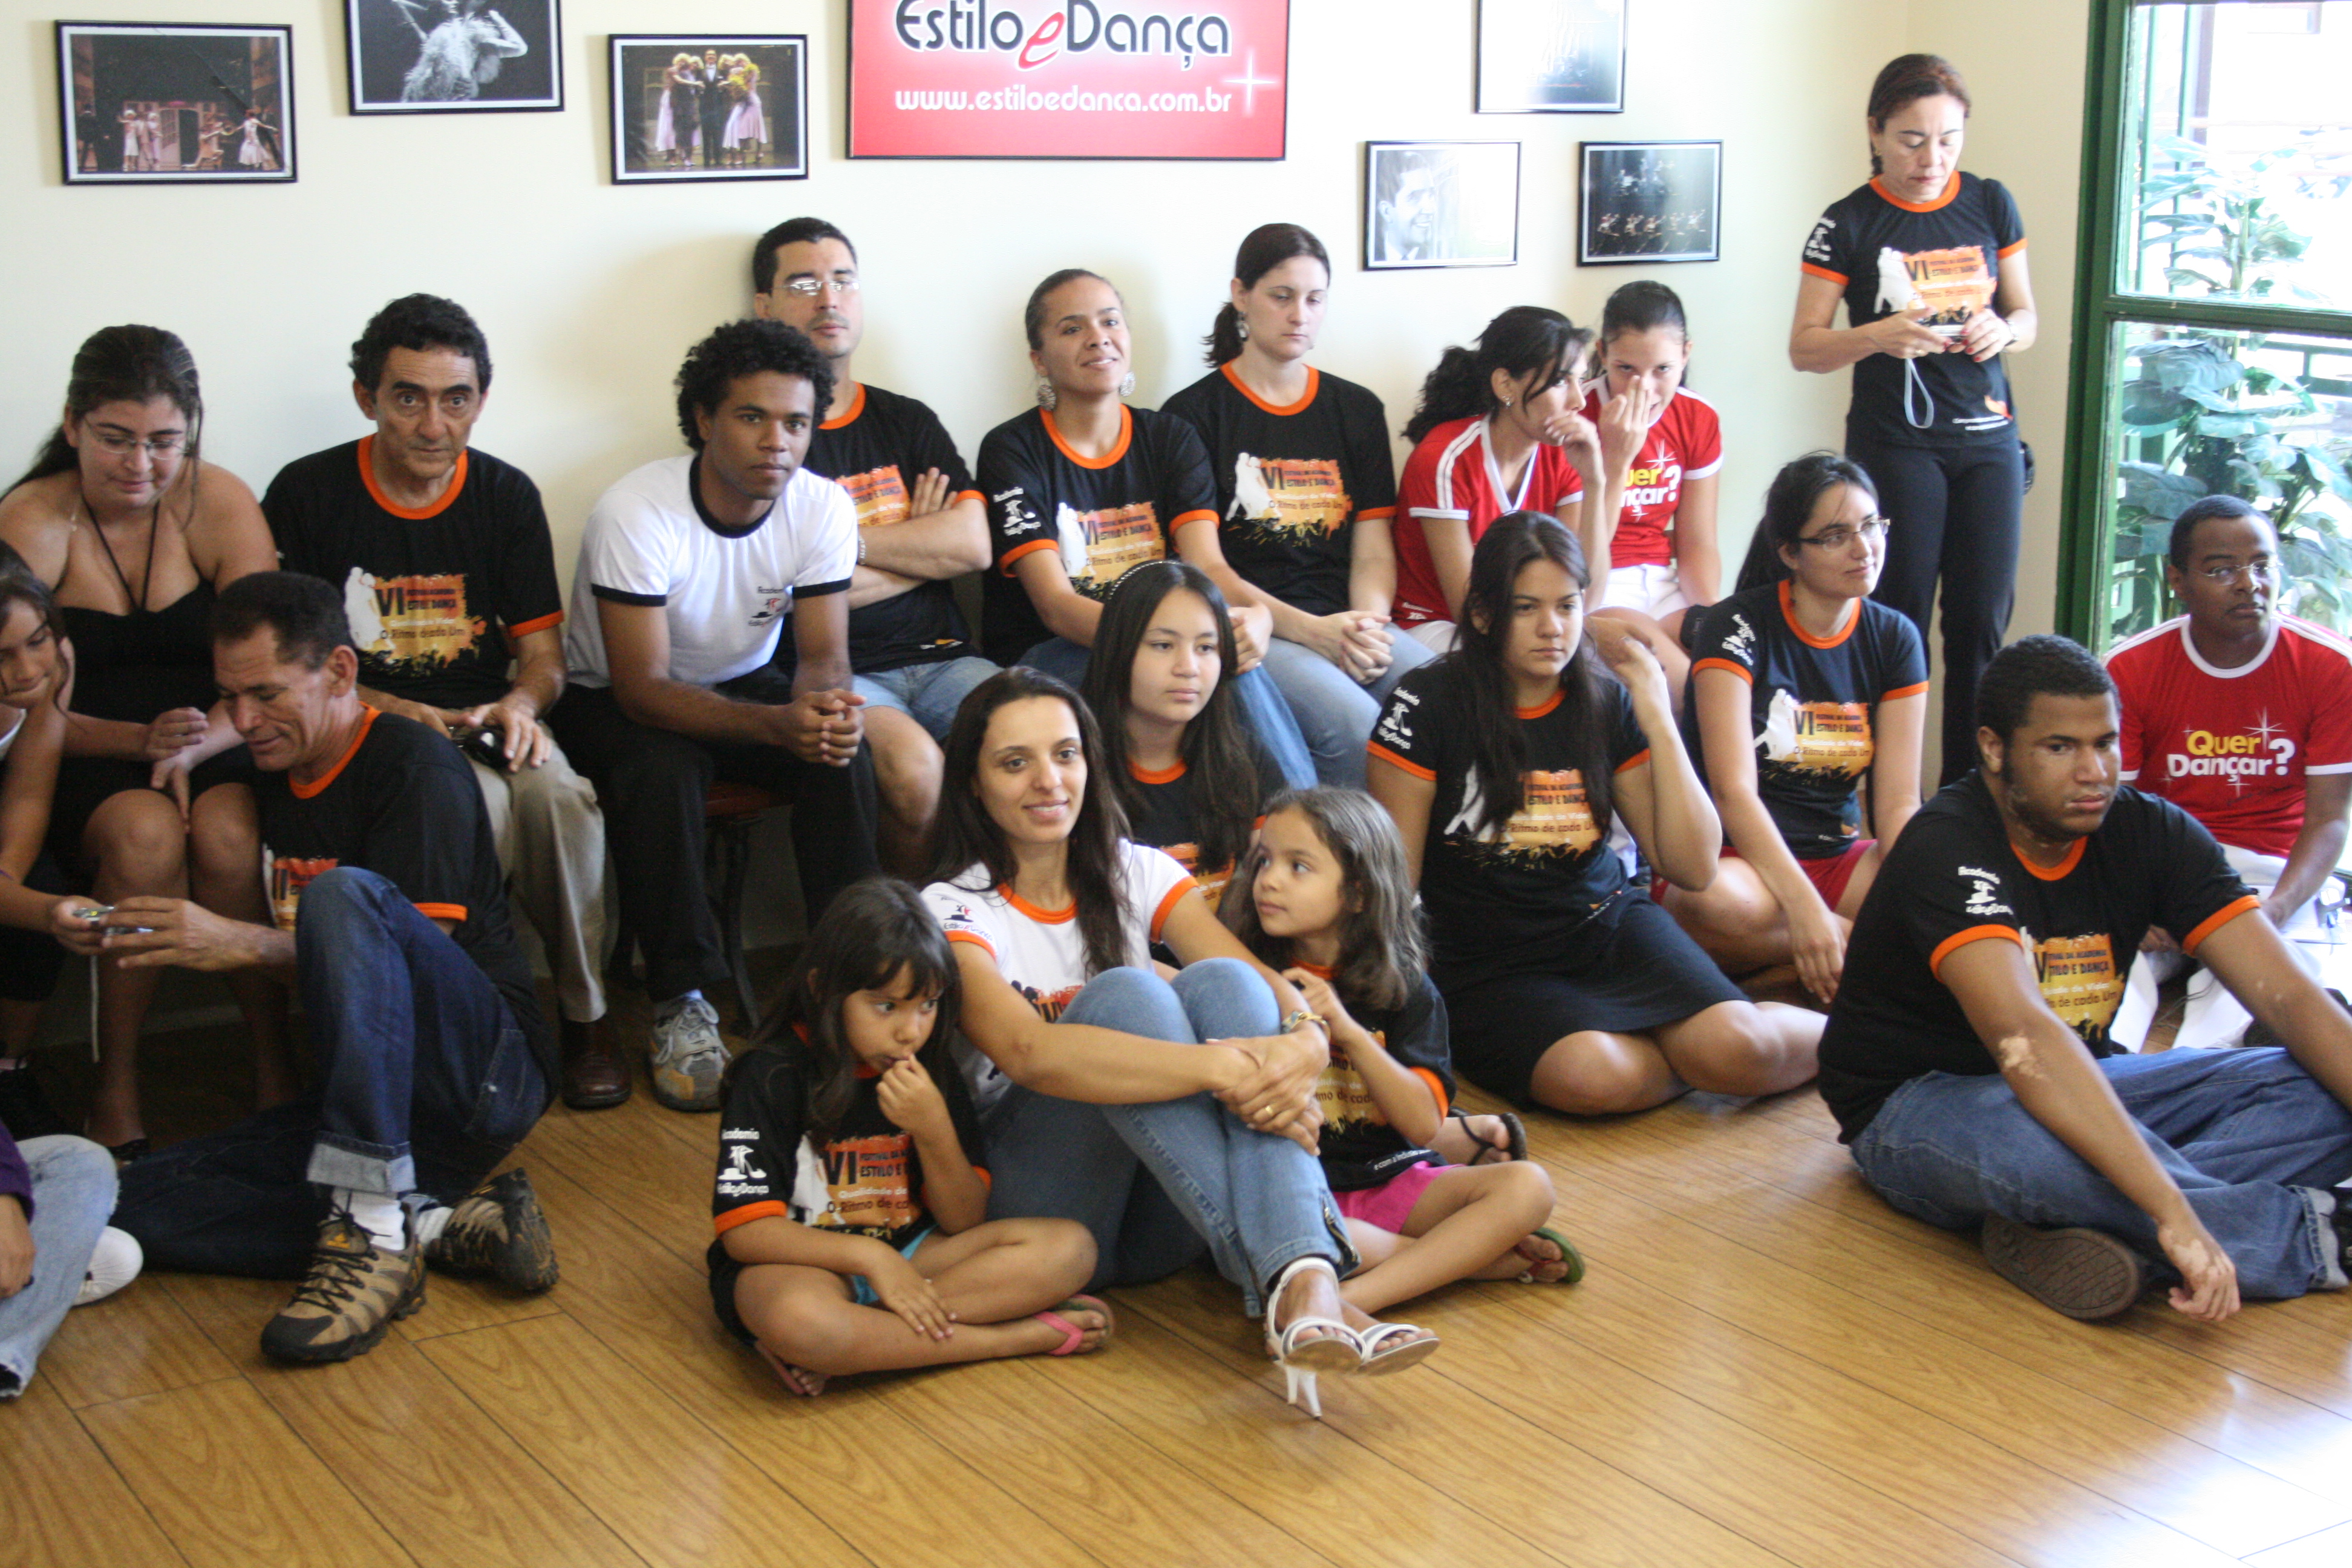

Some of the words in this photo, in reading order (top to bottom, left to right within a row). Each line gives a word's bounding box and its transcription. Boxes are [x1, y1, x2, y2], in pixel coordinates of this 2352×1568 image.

[895, 85, 1232, 113] www.estiloedanca.com.br
[1904, 260, 1929, 281] VI
[1261, 467, 1285, 490] VI
[1625, 468, 1663, 488] uer
[375, 587, 404, 616] VI
[1794, 710, 1814, 735] VI
[2186, 730, 2261, 757] Quer
[1511, 823, 1539, 832] Ritmo
[1542, 822, 1555, 832] de
[2081, 961, 2110, 974] DANÇA
[2058, 995, 2071, 1007] de
[2074, 993, 2100, 1005] cada
[824, 1151, 857, 1185] VI
[860, 1165, 894, 1177] ESTILO
[896, 1163, 903, 1175] E
[838, 1186, 892, 1199] Qualidade
[894, 1186, 908, 1195] de
[827, 1201, 835, 1214] O
[840, 1200, 874, 1213] Ritmo
[877, 1197, 892, 1208] de
